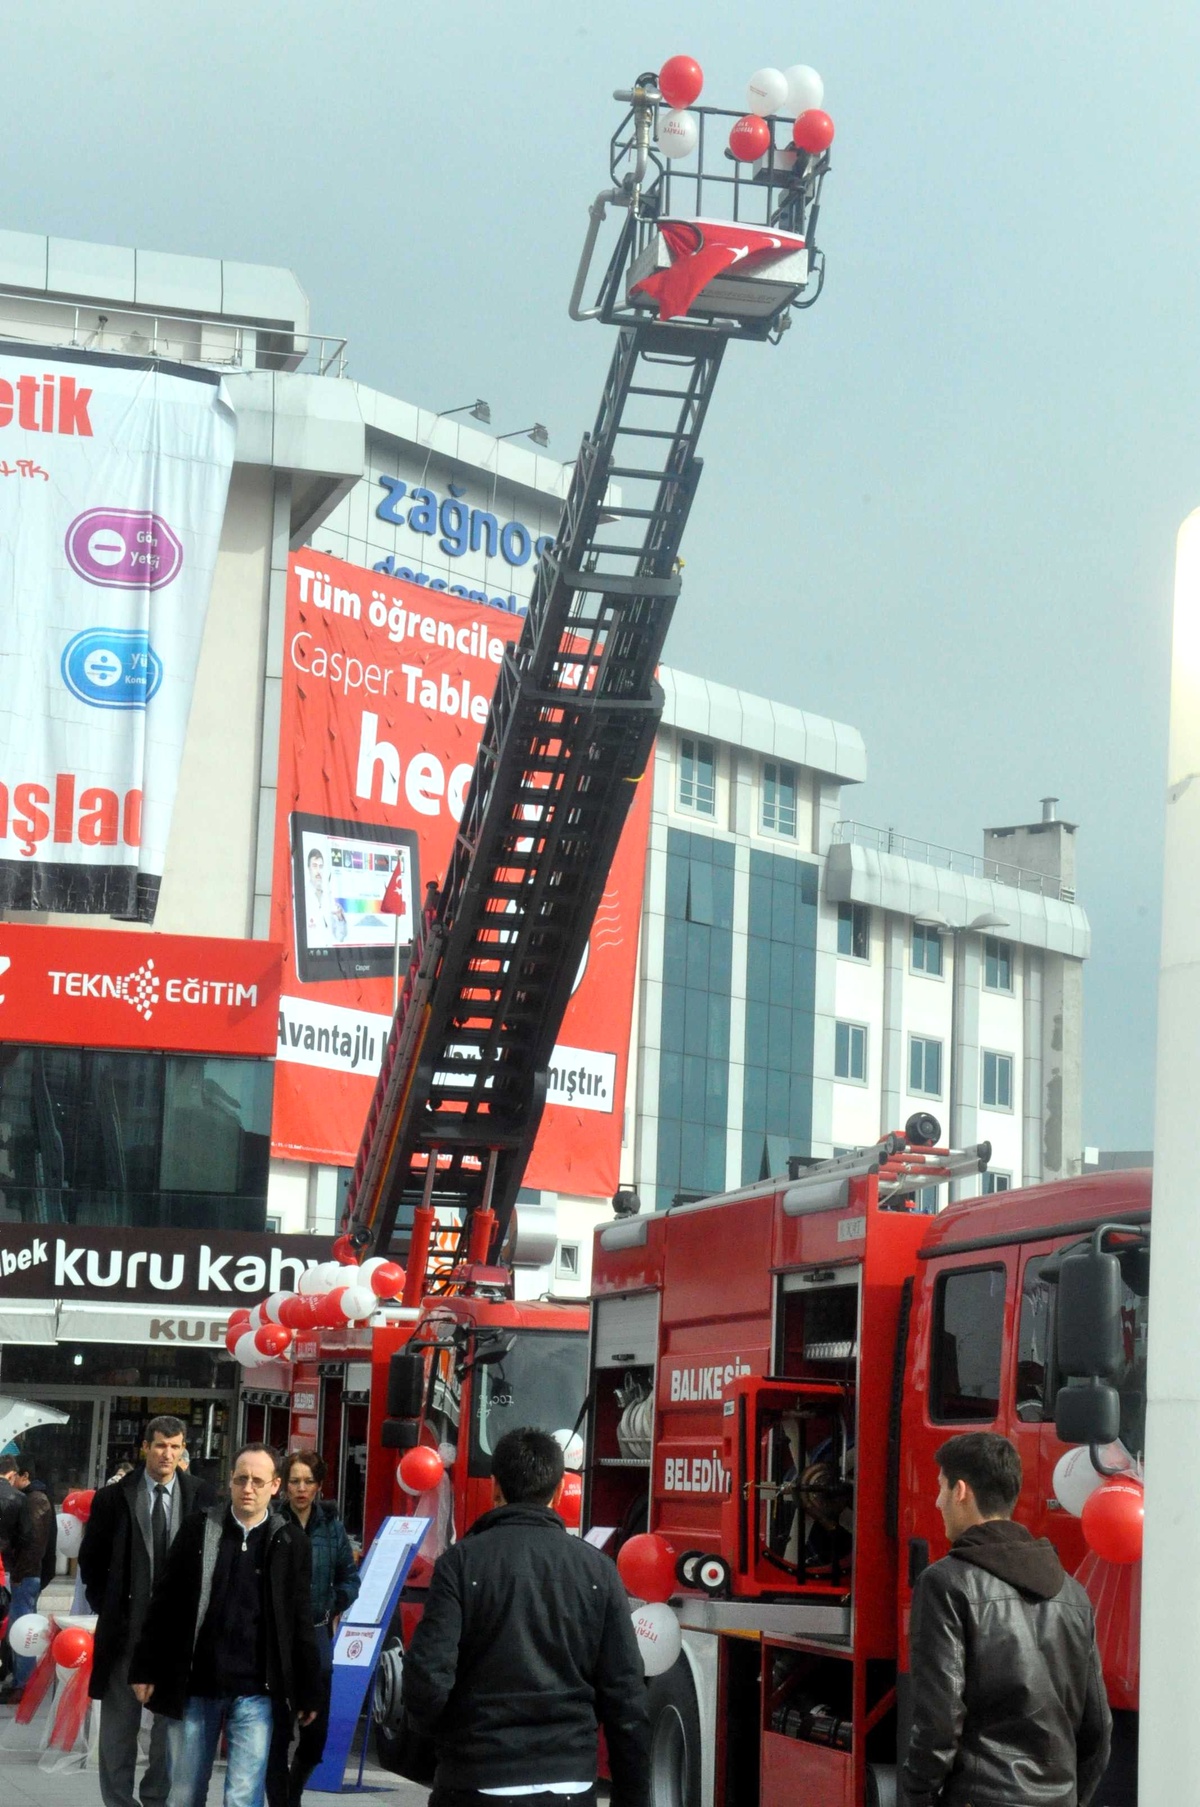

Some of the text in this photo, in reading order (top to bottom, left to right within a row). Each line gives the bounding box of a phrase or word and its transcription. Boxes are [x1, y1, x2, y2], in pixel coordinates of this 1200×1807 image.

[294, 565, 361, 620] Tüm
[291, 632, 394, 696] Casper
[401, 664, 491, 724] Table
[277, 1010, 374, 1068] Avantajlı
[0, 1238, 341, 1293] bek kuru kah
[634, 1626, 658, 1644] İTFAİ
[637, 1618, 654, 1629] 110
